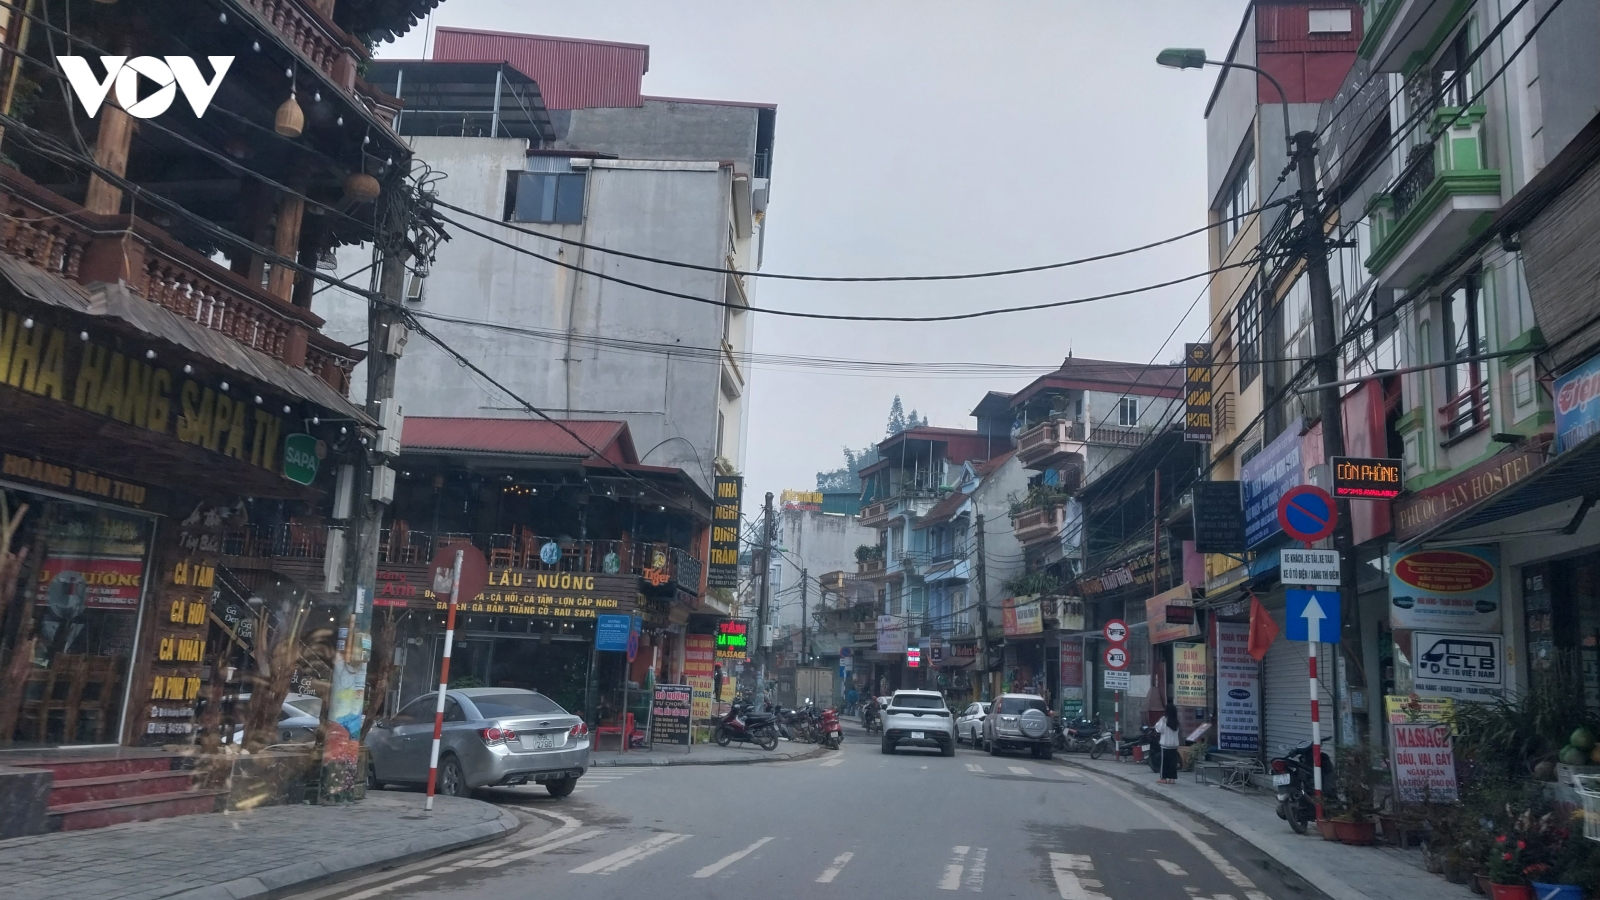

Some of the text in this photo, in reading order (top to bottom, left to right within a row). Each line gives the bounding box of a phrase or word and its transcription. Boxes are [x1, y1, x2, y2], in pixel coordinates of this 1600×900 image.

[1187, 366, 1211, 382] MINH
[177, 379, 245, 460] SAPA
[1187, 413, 1212, 427] HOTEL
[286, 446, 316, 472] SAPA
[1337, 461, 1399, 483] CÒN PHÒNG
[74, 468, 112, 496] VĂN
[112, 480, 147, 509] THỤ
[718, 480, 738, 498] NHÀ
[1442, 482, 1469, 513] LAN
[1471, 454, 1532, 501] HOSTEL
[1337, 487, 1399, 498] ROOMS AVAILABLE
[715, 500, 739, 520] NGHỈ
[713, 526, 737, 545] ĐỊNH
[711, 546, 737, 565] TRÂM
[1284, 553, 1290, 563] XE
[1325, 554, 1334, 564] TAXI
[175, 558, 188, 585] CÁ
[489, 568, 594, 591] LẨU NƯỚNG
[643, 568, 671, 587] Tiger
[1283, 569, 1289, 579] XE
[381, 582, 416, 597] Anh
[171, 596, 185, 623] CÁ
[456, 602, 467, 611] EN
[555, 608, 570, 617] RAU
[574, 609, 595, 618] SAPA
[159, 633, 174, 661] CÁ
[717, 633, 727, 646] LÁ
[716, 650, 747, 659] MASSAGE
[1446, 655, 1496, 671] CLB
[1461, 668, 1477, 678] VIỆT
[1477, 670, 1496, 679] NAM
[1179, 679, 1203, 687] CHÁO
[1415, 683, 1425, 691] NHÀ
[1396, 727, 1450, 748] MASSAGE
[1418, 752, 1434, 766] VAI,
[1430, 779, 1445, 787] DAO
